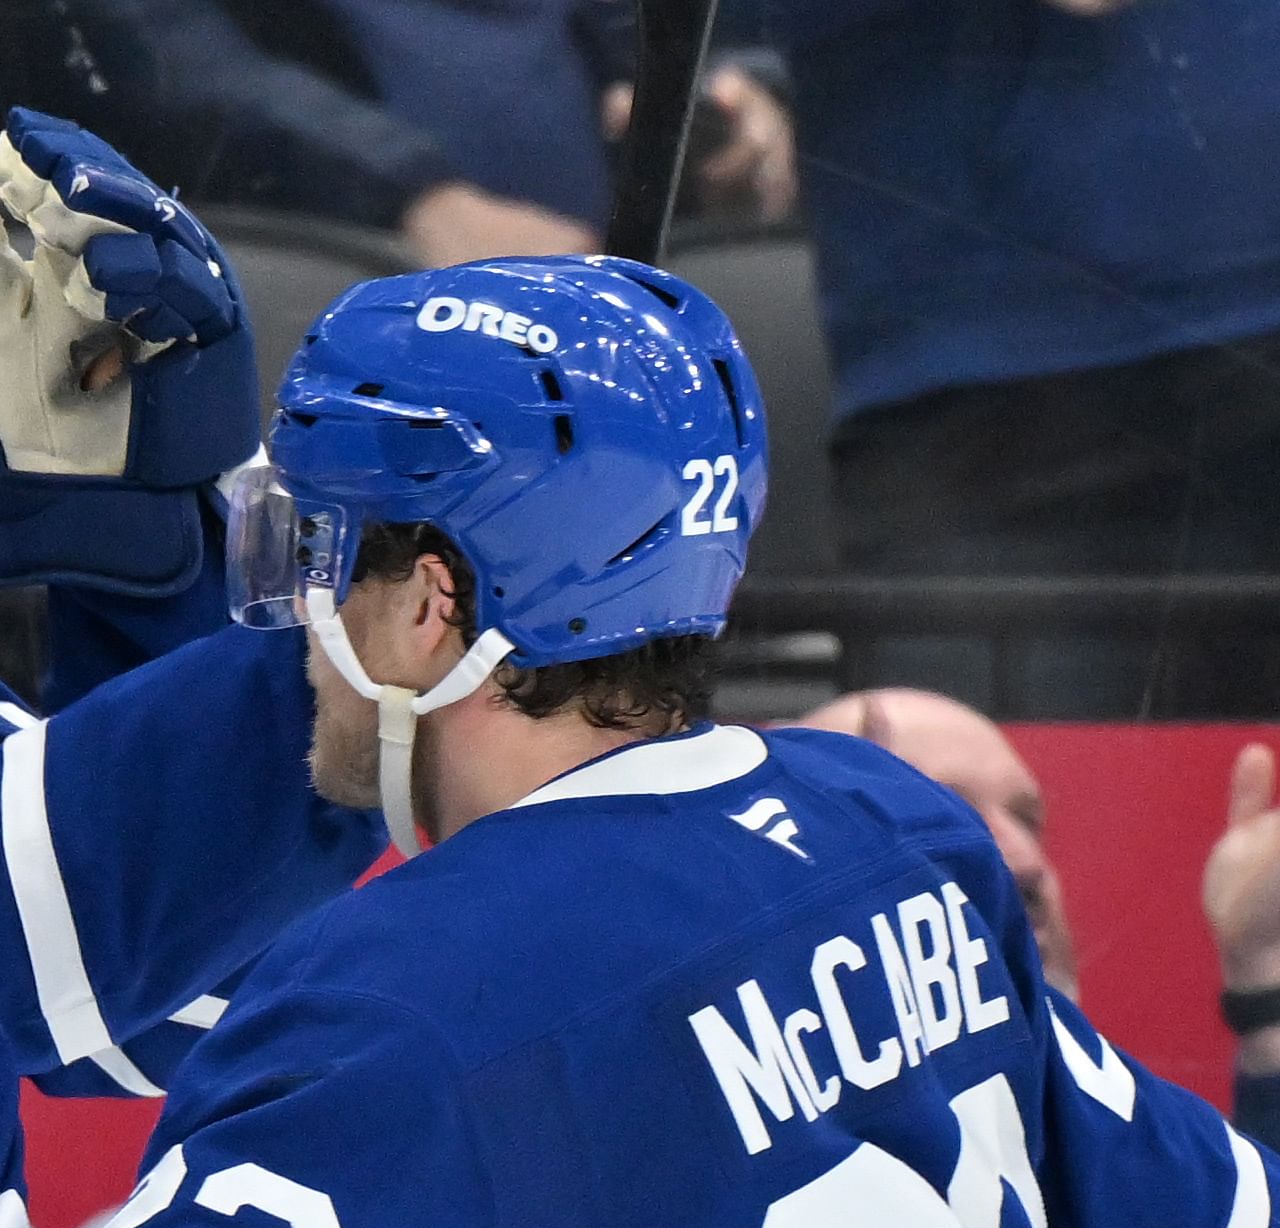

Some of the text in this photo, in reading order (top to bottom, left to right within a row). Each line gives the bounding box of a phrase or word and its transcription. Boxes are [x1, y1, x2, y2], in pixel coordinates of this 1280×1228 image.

[416, 297, 558, 354] OREO
[681, 454, 738, 537] 22
[688, 881, 1010, 1156] McCABE
